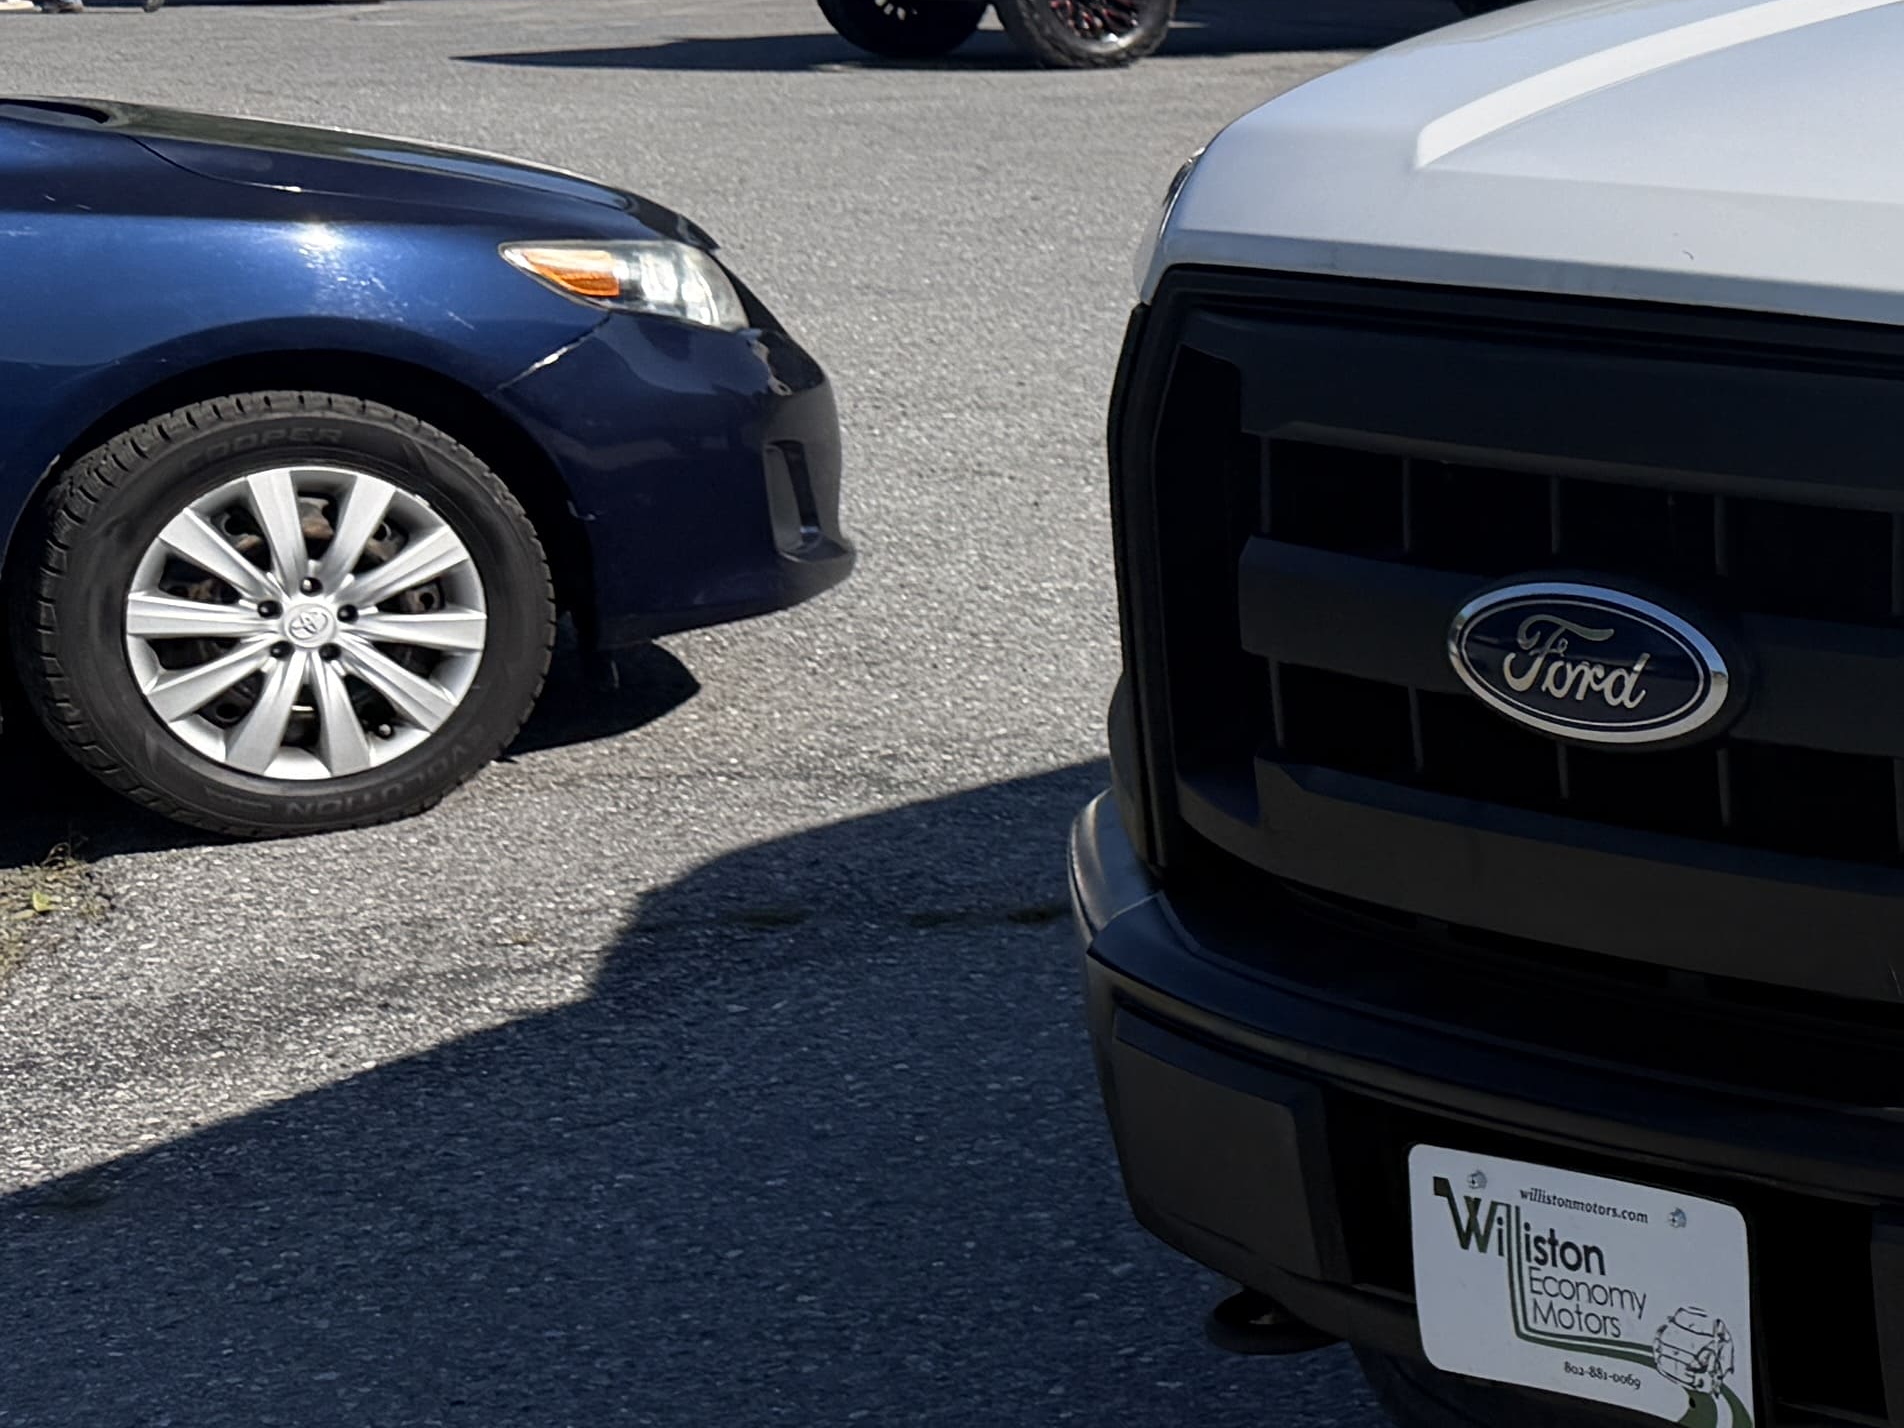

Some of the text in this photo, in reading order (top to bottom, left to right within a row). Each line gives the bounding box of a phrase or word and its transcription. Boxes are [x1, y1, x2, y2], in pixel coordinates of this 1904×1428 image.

[1503, 614, 1651, 709] Ford
[1433, 1175, 1606, 1276] Williston
[1519, 1187, 1649, 1224] willistonmotors.com
[1528, 1266, 1647, 1320] Economy
[1533, 1297, 1622, 1339] Motors
[1564, 1361, 1642, 1390] 802-881-0069
